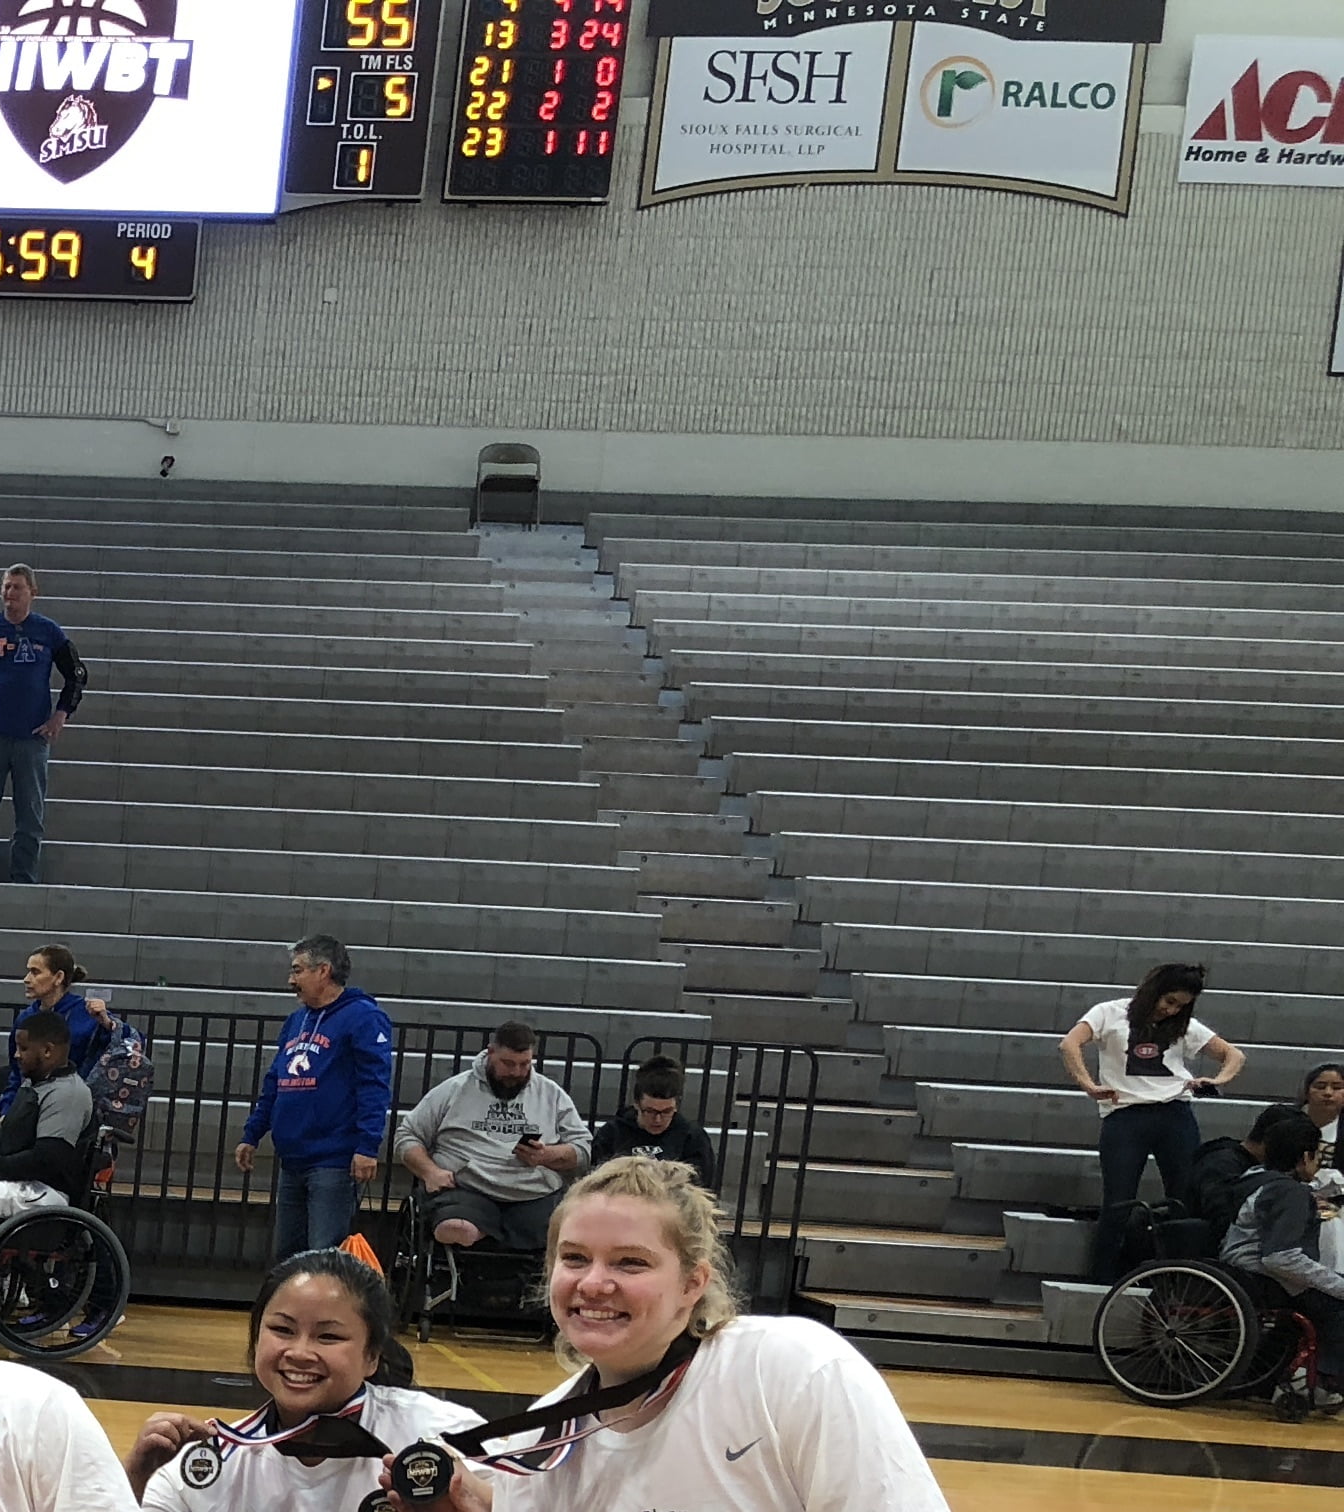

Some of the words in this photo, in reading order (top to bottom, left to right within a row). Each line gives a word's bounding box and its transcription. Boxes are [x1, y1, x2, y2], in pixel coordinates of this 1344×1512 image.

[347, 0, 409, 46] 55
[764, 4, 936, 30] MINNESOTA
[961, 8, 1046, 32] STATE
[485, 19, 515, 49] 13
[550, 19, 569, 49] 3
[579, 19, 621, 50] 24
[360, 55, 381, 70] TM
[386, 55, 413, 71] FLS
[469, 56, 511, 86] 21
[554, 59, 563, 84] 1
[596, 56, 617, 87] 0
[703, 50, 853, 104] SFSH
[385, 76, 409, 117] 5
[466, 91, 507, 120] 22
[539, 90, 560, 121] 2
[591, 91, 612, 121] 2
[1001, 81, 1116, 110] RALCO
[39, 125, 109, 163] SMSU
[341, 124, 383, 140] T.O.L.
[462, 127, 503, 157] 23
[545, 129, 556, 155] 1
[577, 129, 608, 155] 11
[680, 124, 729, 136] SIOUX
[735, 124, 778, 136] FALLS
[786, 124, 863, 137] SURGICAL
[798, 144, 825, 156] LLP
[1185, 146, 1246, 164] Home
[1255, 147, 1270, 164] &
[357, 149, 369, 183] 1
[117, 222, 172, 239] PERIOD
[131, 246, 157, 280] 4
